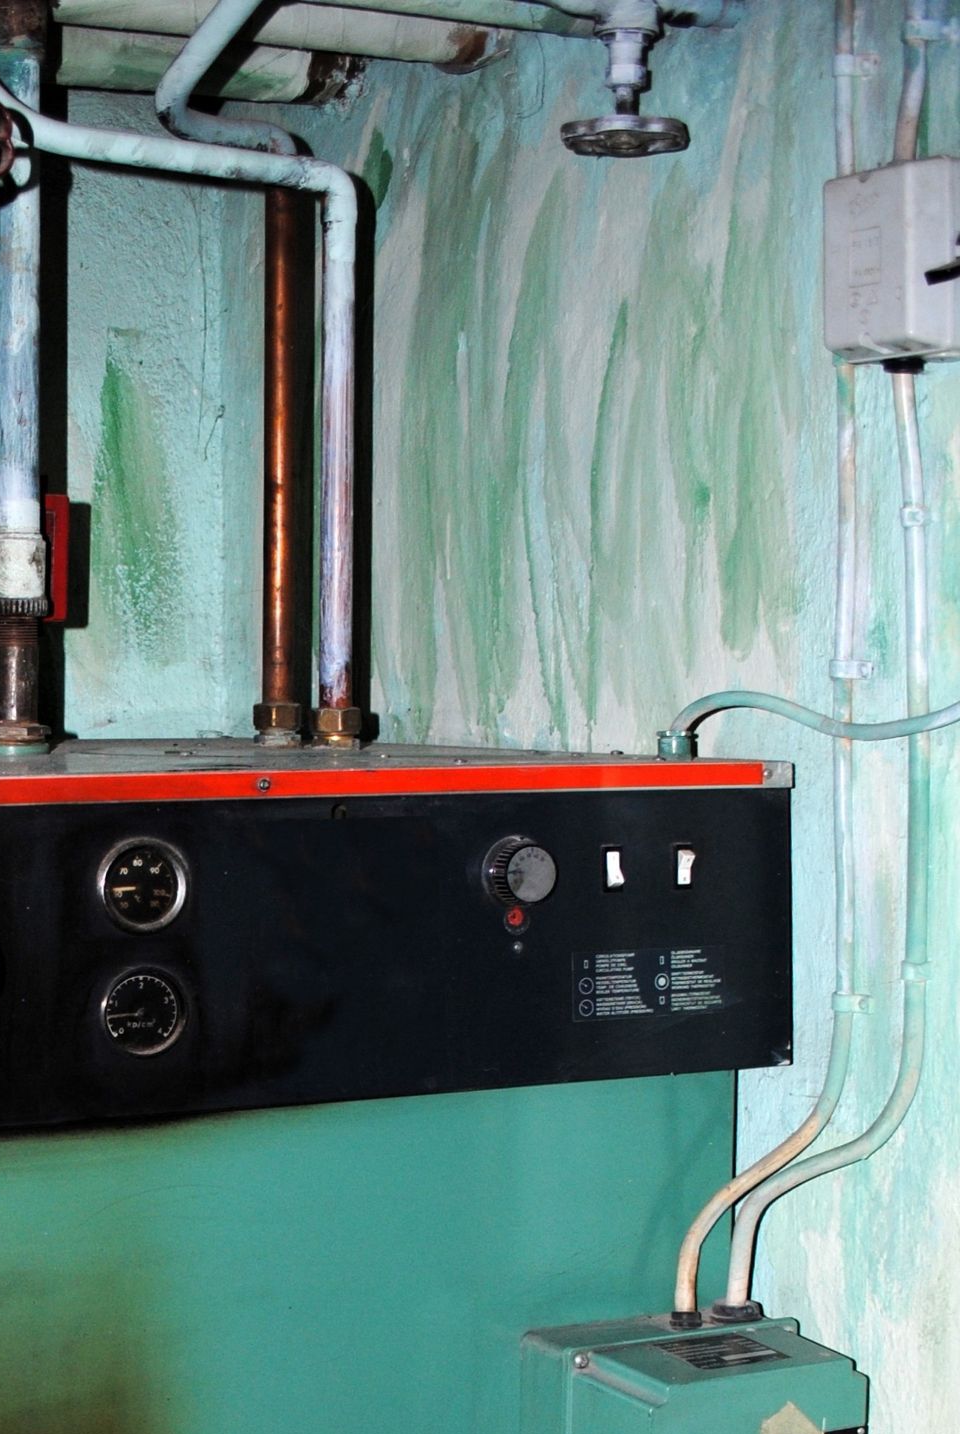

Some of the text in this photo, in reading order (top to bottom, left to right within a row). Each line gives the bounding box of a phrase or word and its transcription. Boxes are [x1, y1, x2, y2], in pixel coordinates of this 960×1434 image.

[132, 859, 143, 867] 80
[119, 867, 129, 875] 70
[139, 982, 145, 990] 2
[118, 1027, 125, 1035] 0
